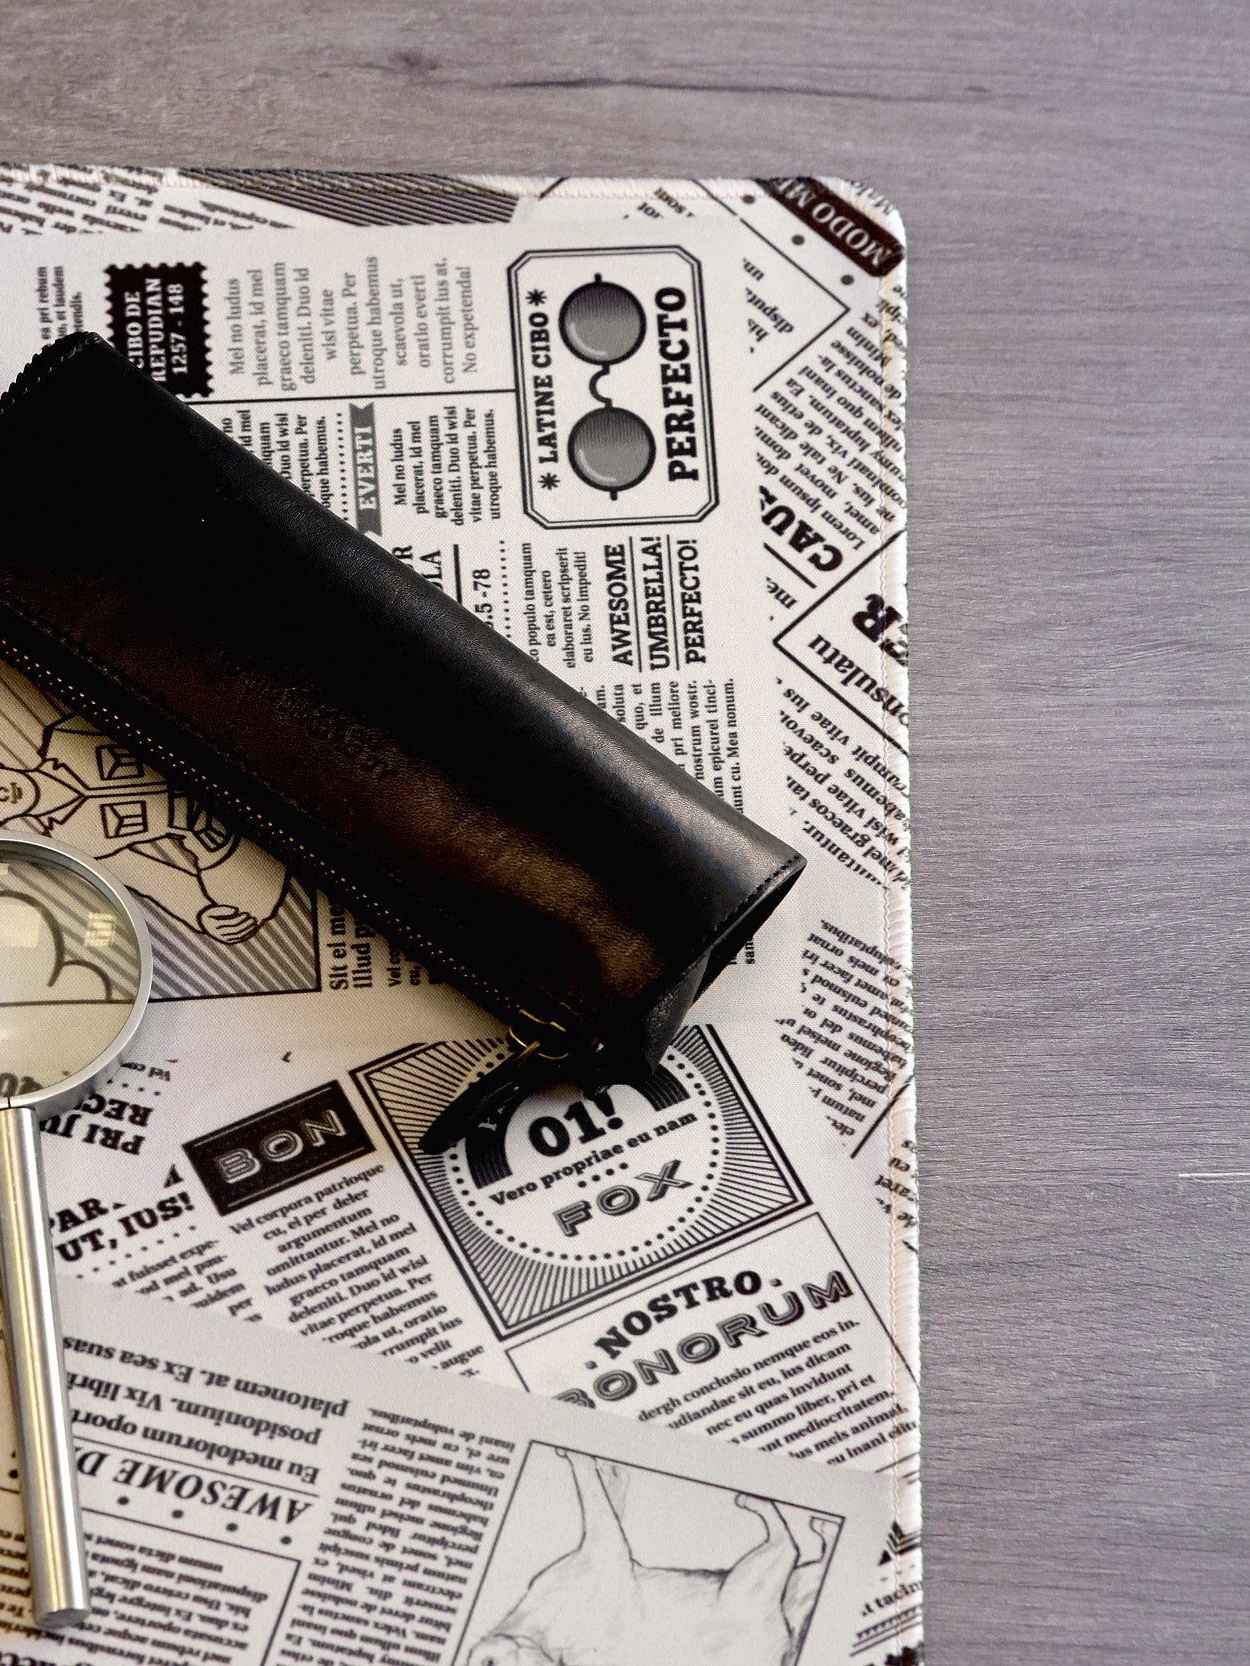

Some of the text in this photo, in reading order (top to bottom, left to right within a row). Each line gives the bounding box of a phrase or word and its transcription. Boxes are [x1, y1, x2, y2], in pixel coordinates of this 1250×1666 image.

[124, 291, 141, 317] DE
[167, 283, 184, 314] 148
[170, 332, 188, 374] 1257
[528, 311, 559, 464] LATINE CIBO
[654, 286, 699, 482] PERFECTO
[354, 426, 377, 510] EVERTI
[428, 415, 449, 519] graeco tamquam
[463, 407, 484, 523] vitae perpetua. Per
[483, 409, 503, 520] utroque habemus.
[603, 543, 634, 667] AWESOME
[640, 536, 671, 671] UMBRELLA!
[676, 539, 707, 665] PERFECTO!
[82, 1124, 146, 1155] PRI
[218, 1109, 347, 1184] BON
[488, 1113, 698, 1206] Vero propriae eu nam
[117, 1191, 195, 1238] IUS!
[228, 1164, 385, 1235] Vel corpora patrioque
[552, 1159, 694, 1238] FOX
[597, 1268, 764, 1356] NOSTRO
[119, 1350, 160, 1371] sea
[162, 1361, 194, 1384] Ex
[199, 1369, 231, 1388] at.
[683, 1367, 752, 1403] conclusio
[752, 1339, 811, 1371] nemque
[812, 1327, 839, 1344] eos
[837, 1319, 860, 1333] in.
[124, 1386, 322, 1446] posidonium. Vix
[233, 1378, 350, 1419] platonem
[112, 1458, 312, 1524] AWESOME
[141, 1426, 320, 1485] Eu medolorum
